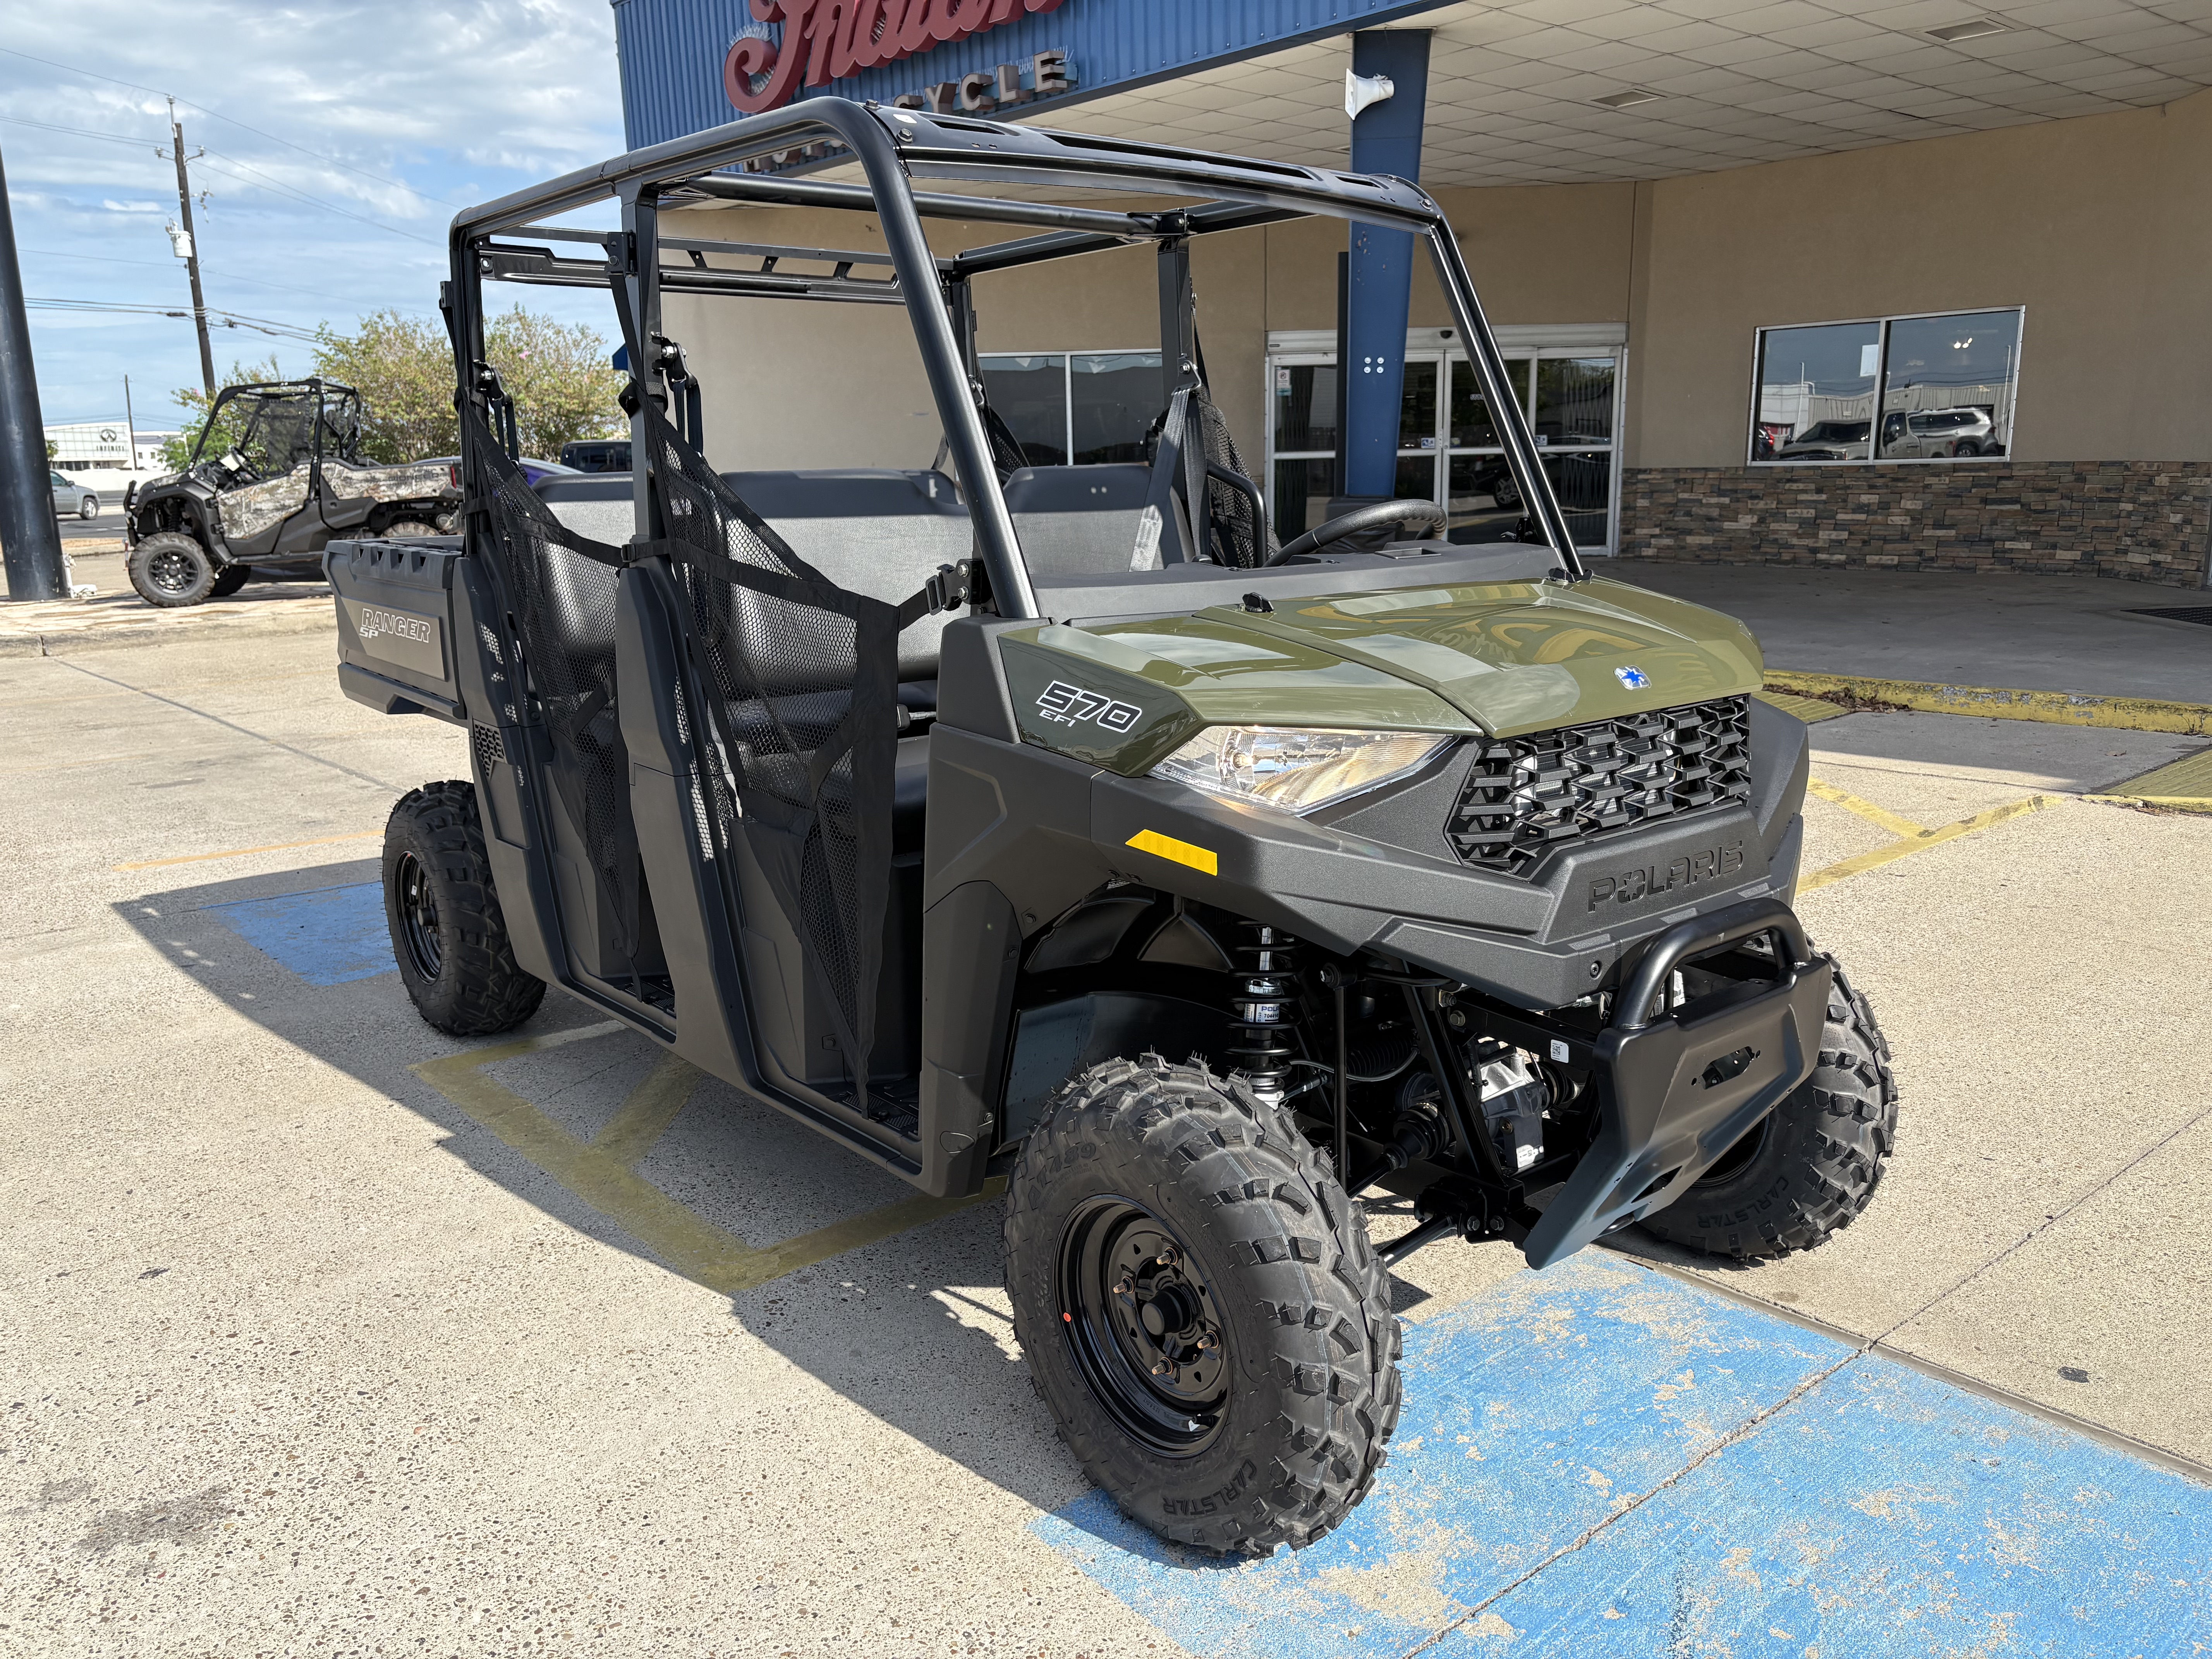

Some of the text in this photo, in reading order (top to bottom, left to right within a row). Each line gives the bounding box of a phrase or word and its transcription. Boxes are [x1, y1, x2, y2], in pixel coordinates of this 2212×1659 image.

[724, 0, 1062, 113] India
[359, 626, 378, 639] SP
[362, 608, 431, 643] RANGER
[1035, 680, 1142, 733] 570
[1039, 709, 1076, 727] EFI
[1588, 840, 1743, 914] POLARIS
[1697, 1176, 1789, 1229] CARLSTAR
[1162, 1458, 1257, 1516] CARLSTAR
